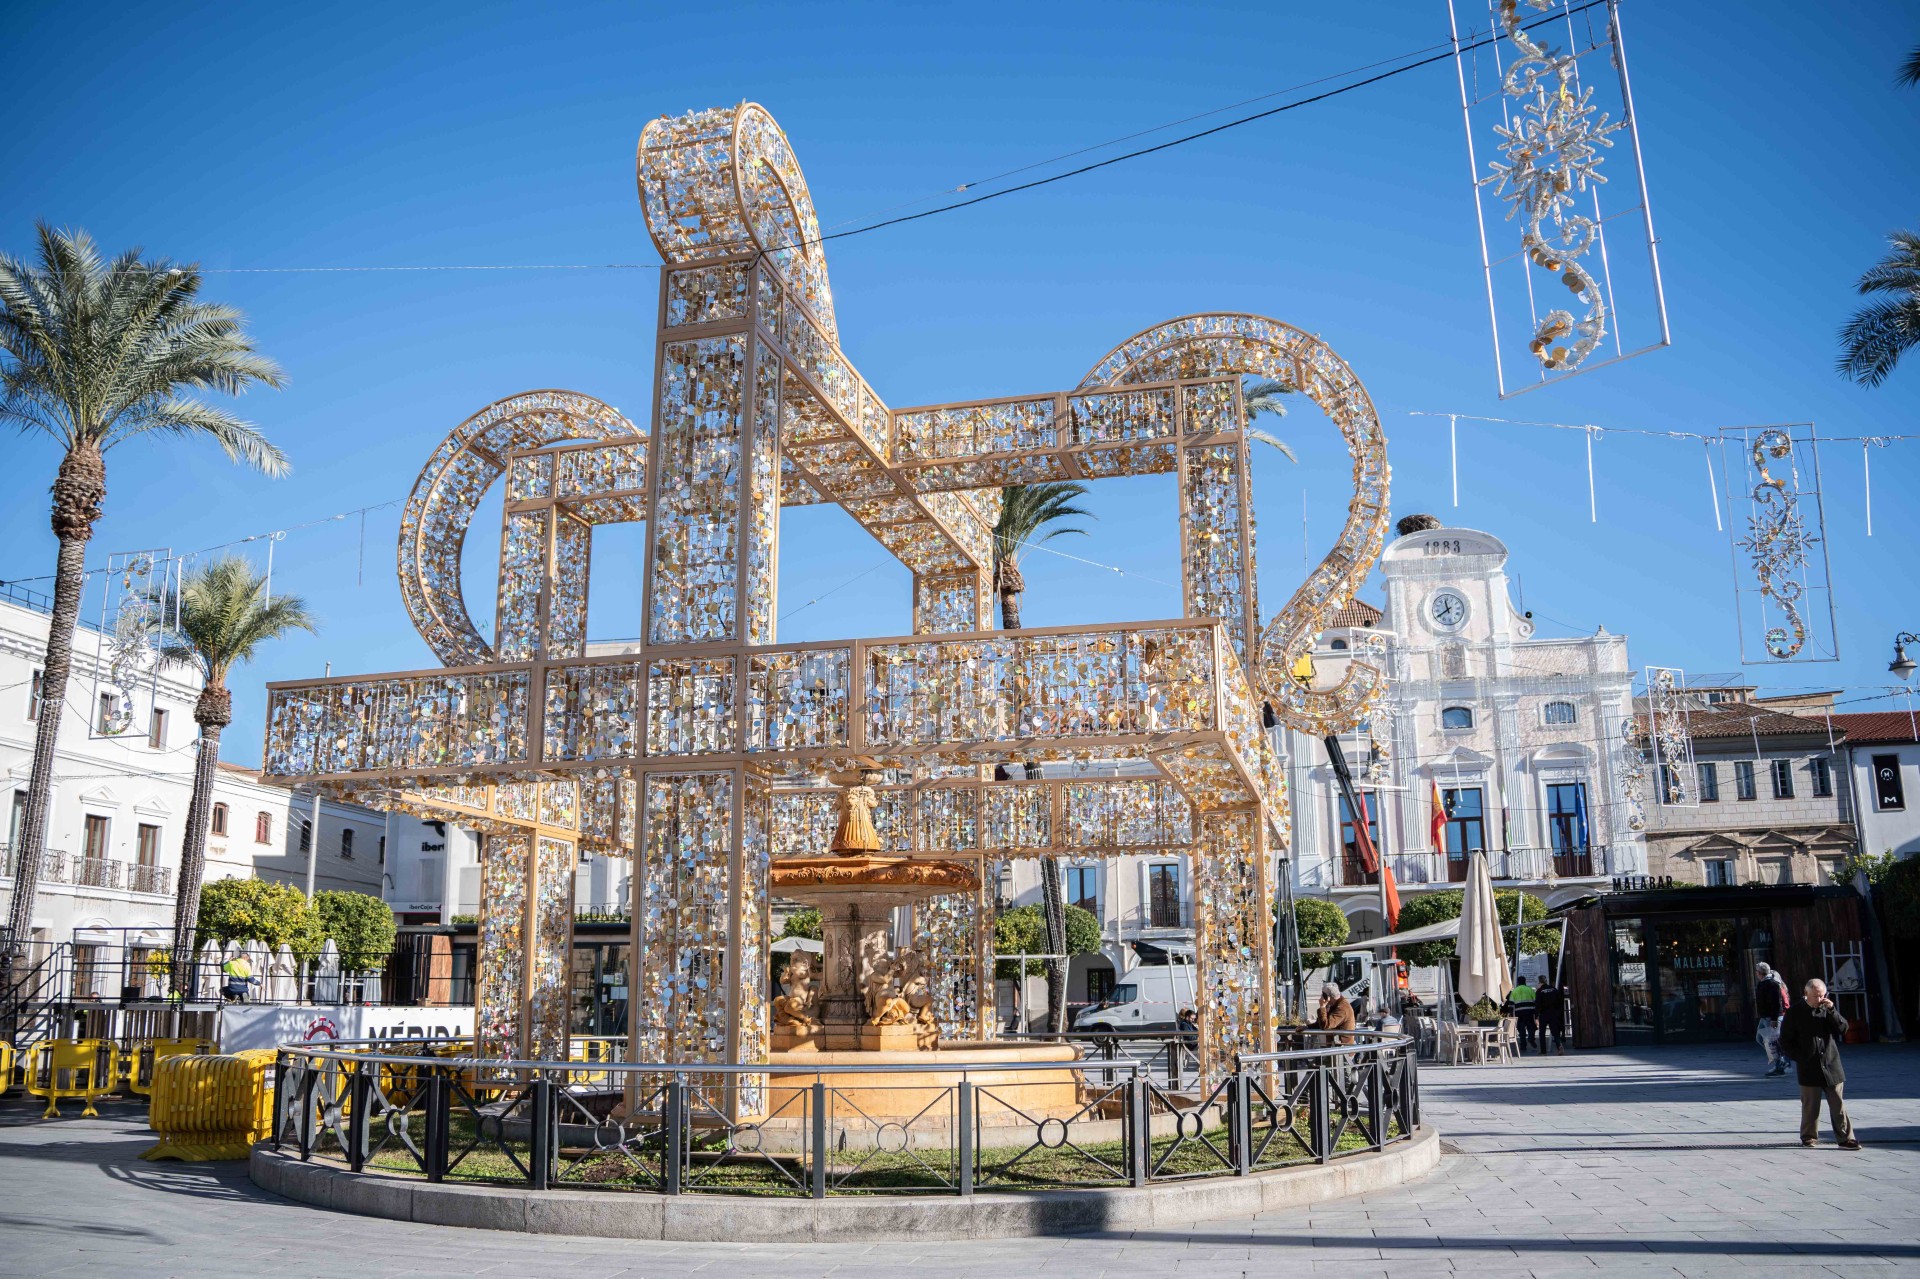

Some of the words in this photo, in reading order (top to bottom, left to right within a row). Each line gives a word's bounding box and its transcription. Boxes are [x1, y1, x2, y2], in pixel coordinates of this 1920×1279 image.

[1425, 541, 1460, 556] 1883
[1612, 875, 1674, 891] MALABAR
[1674, 955, 1725, 969] MALABAR
